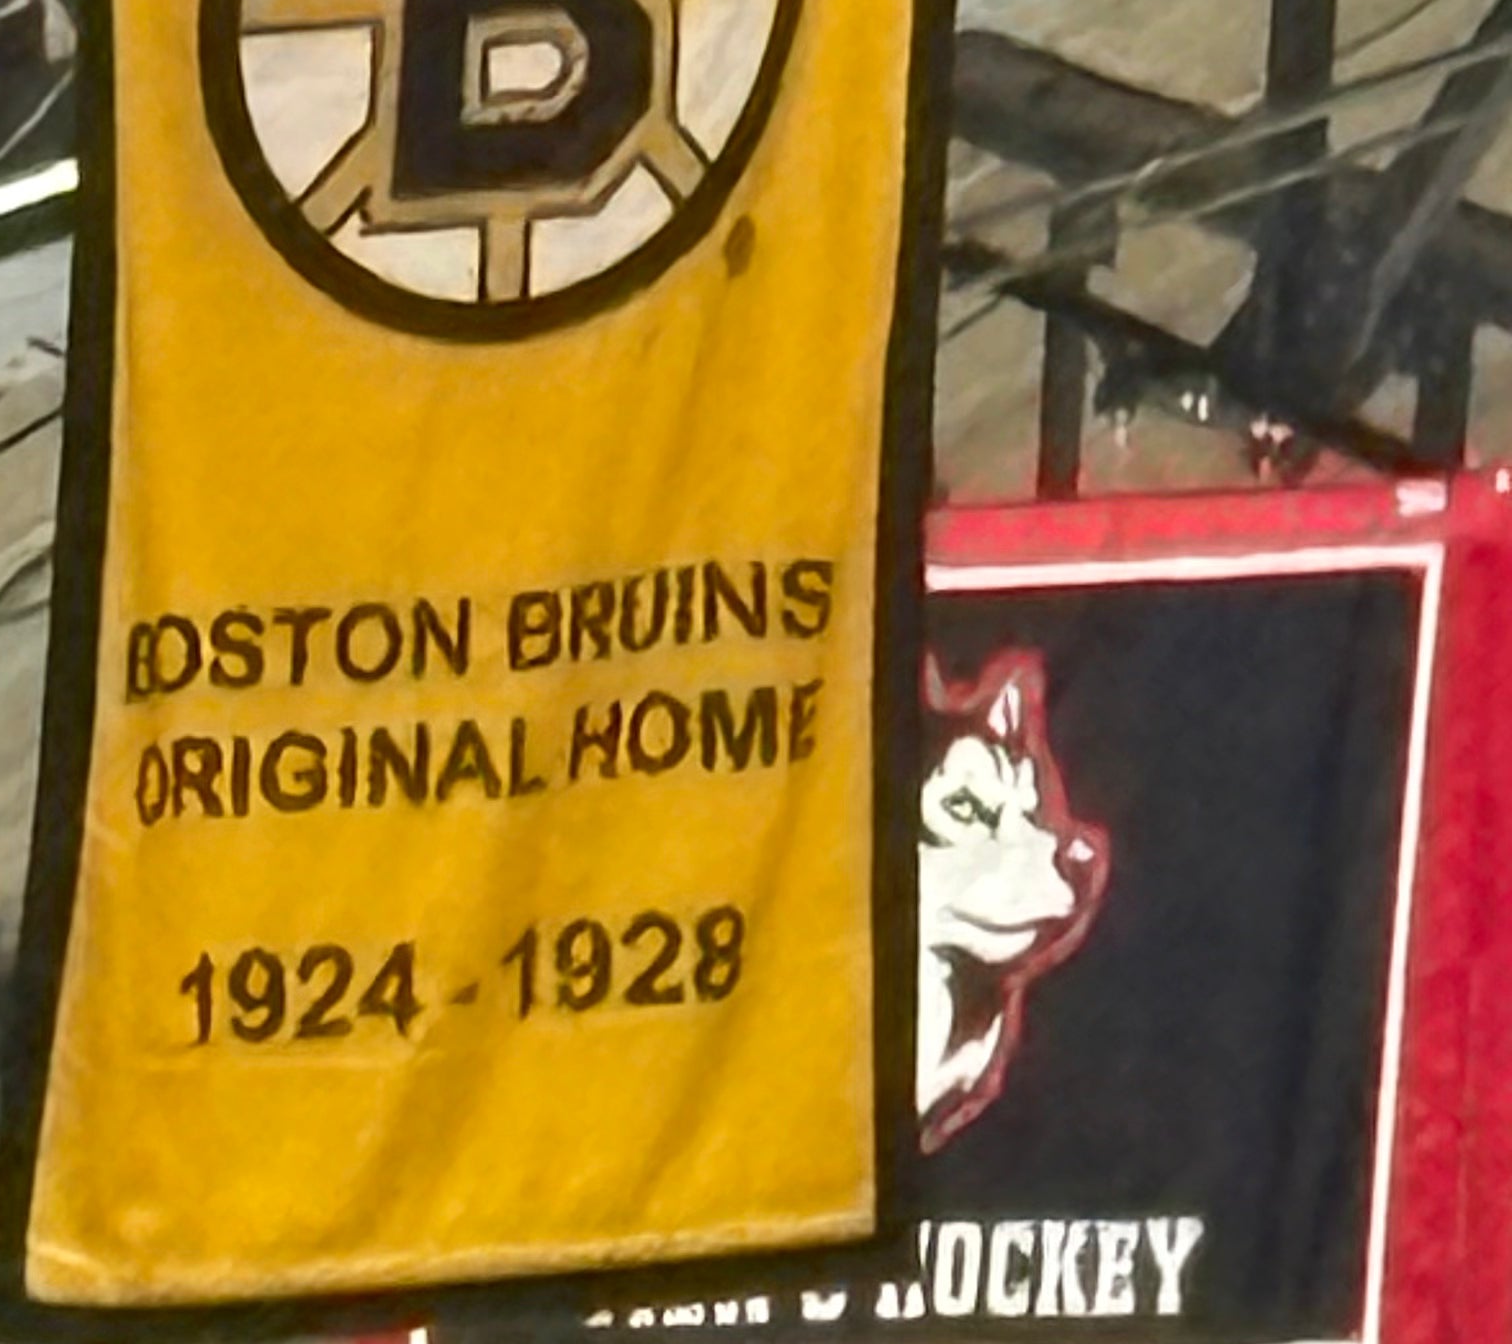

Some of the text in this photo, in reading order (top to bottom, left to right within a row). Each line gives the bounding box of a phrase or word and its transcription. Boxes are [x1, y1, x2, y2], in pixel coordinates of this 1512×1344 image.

[125, 559, 834, 704] BOSTON BRUINS
[135, 677, 824, 827] ORIGINAL HOME
[180, 940, 422, 1045] 1924
[503, 905, 746, 1021] 1928
